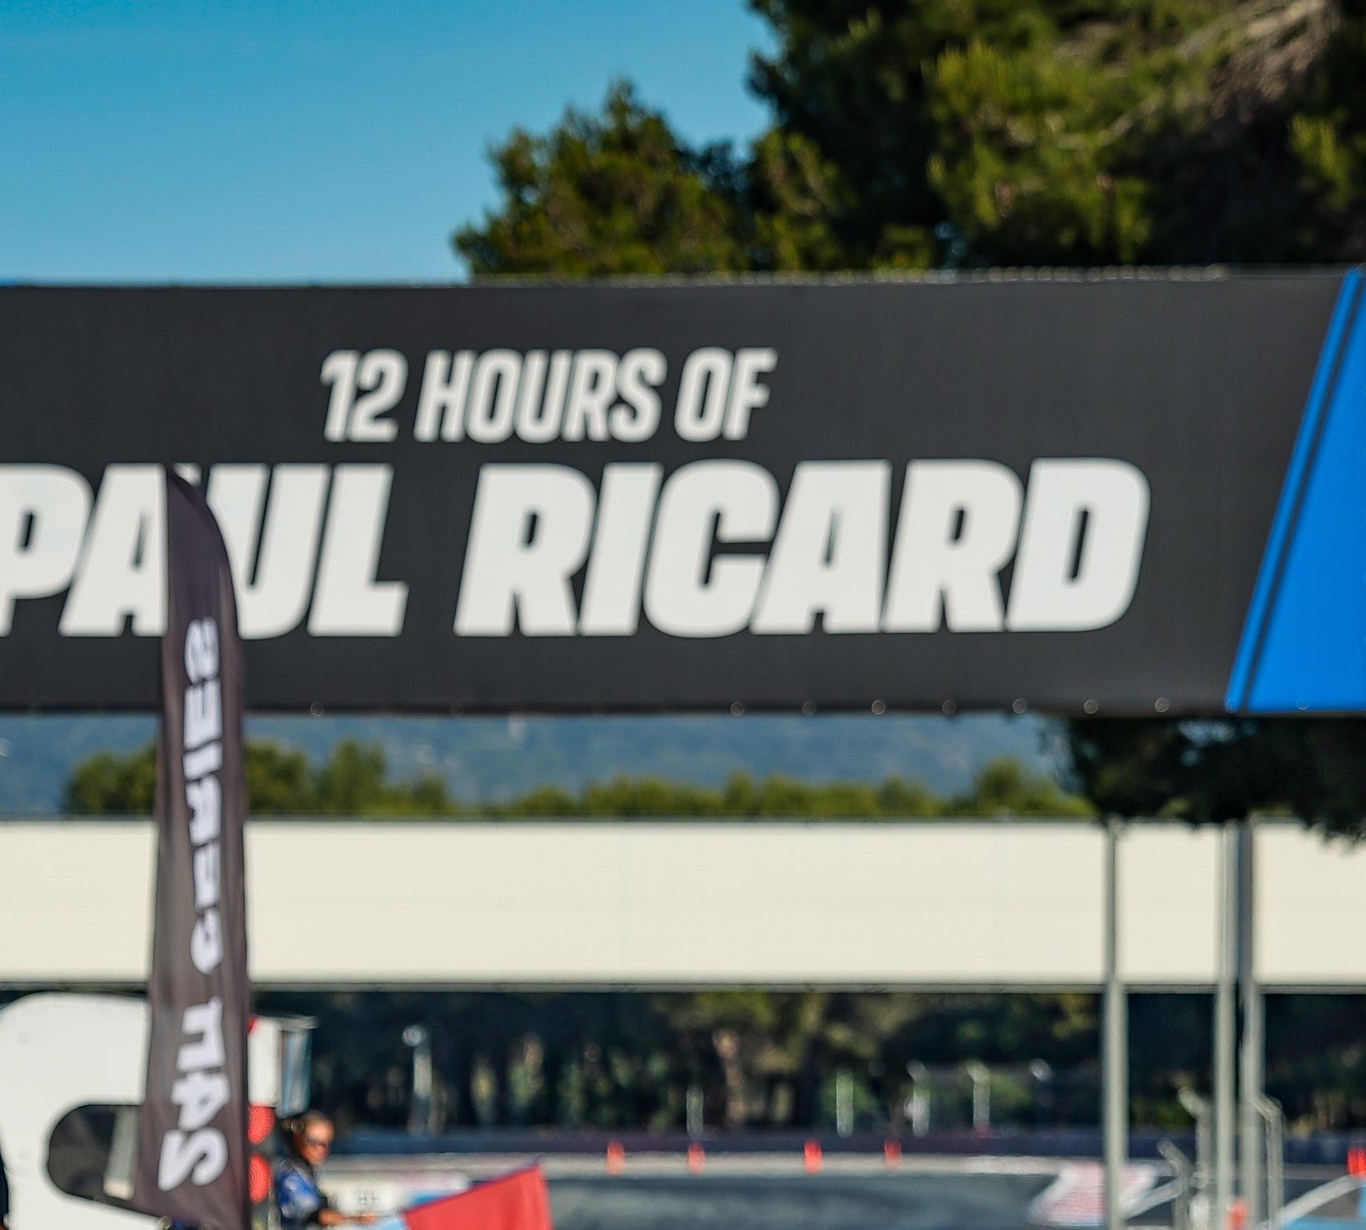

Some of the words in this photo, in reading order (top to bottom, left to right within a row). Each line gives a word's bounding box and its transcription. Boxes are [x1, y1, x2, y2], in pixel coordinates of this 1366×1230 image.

[320, 349, 408, 443] 12
[413, 348, 667, 444] HOURS
[674, 347, 779, 442] OF
[452, 458, 1152, 640] RICARD
